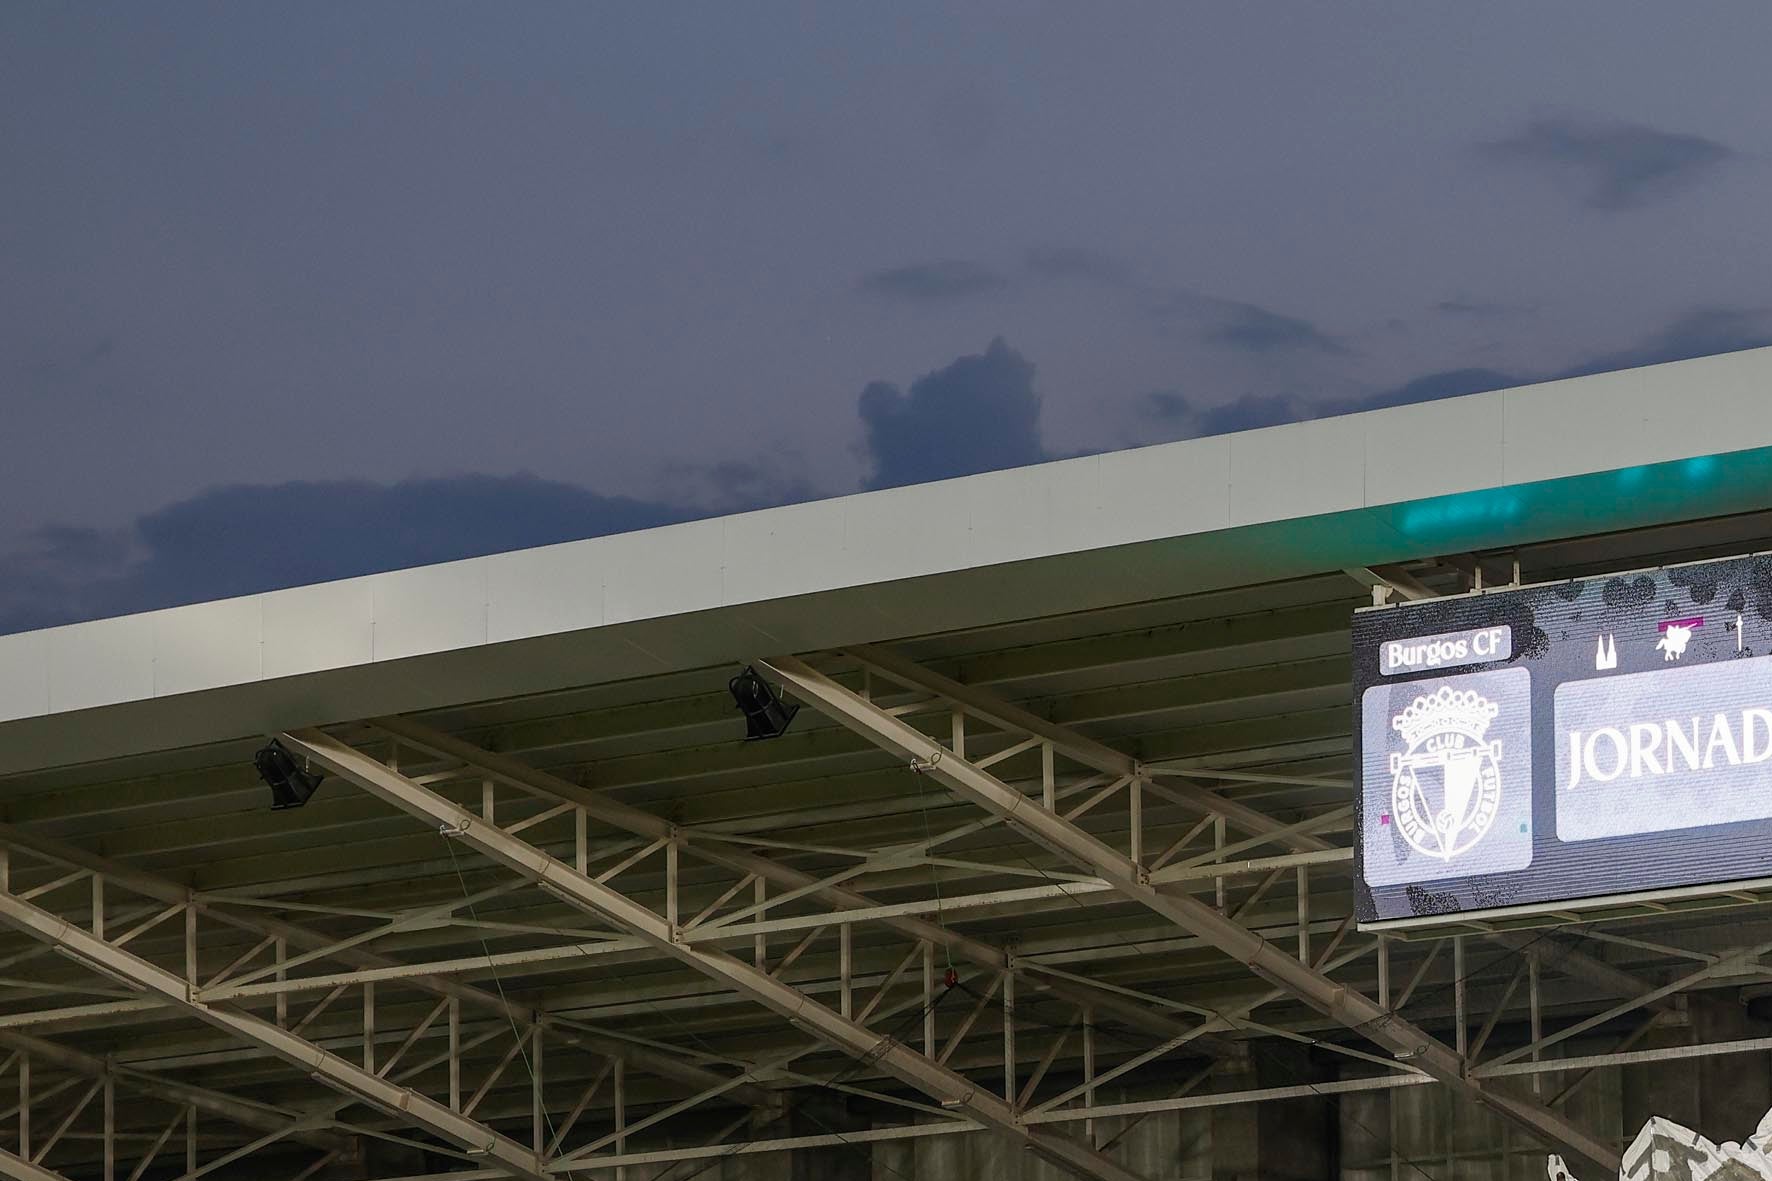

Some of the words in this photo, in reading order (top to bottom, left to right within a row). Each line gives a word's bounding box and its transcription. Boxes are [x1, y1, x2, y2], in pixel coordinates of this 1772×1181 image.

[1388, 638, 1469, 669] Burgos
[1472, 628, 1502, 656] CF
[1425, 733, 1465, 752] CLUB
